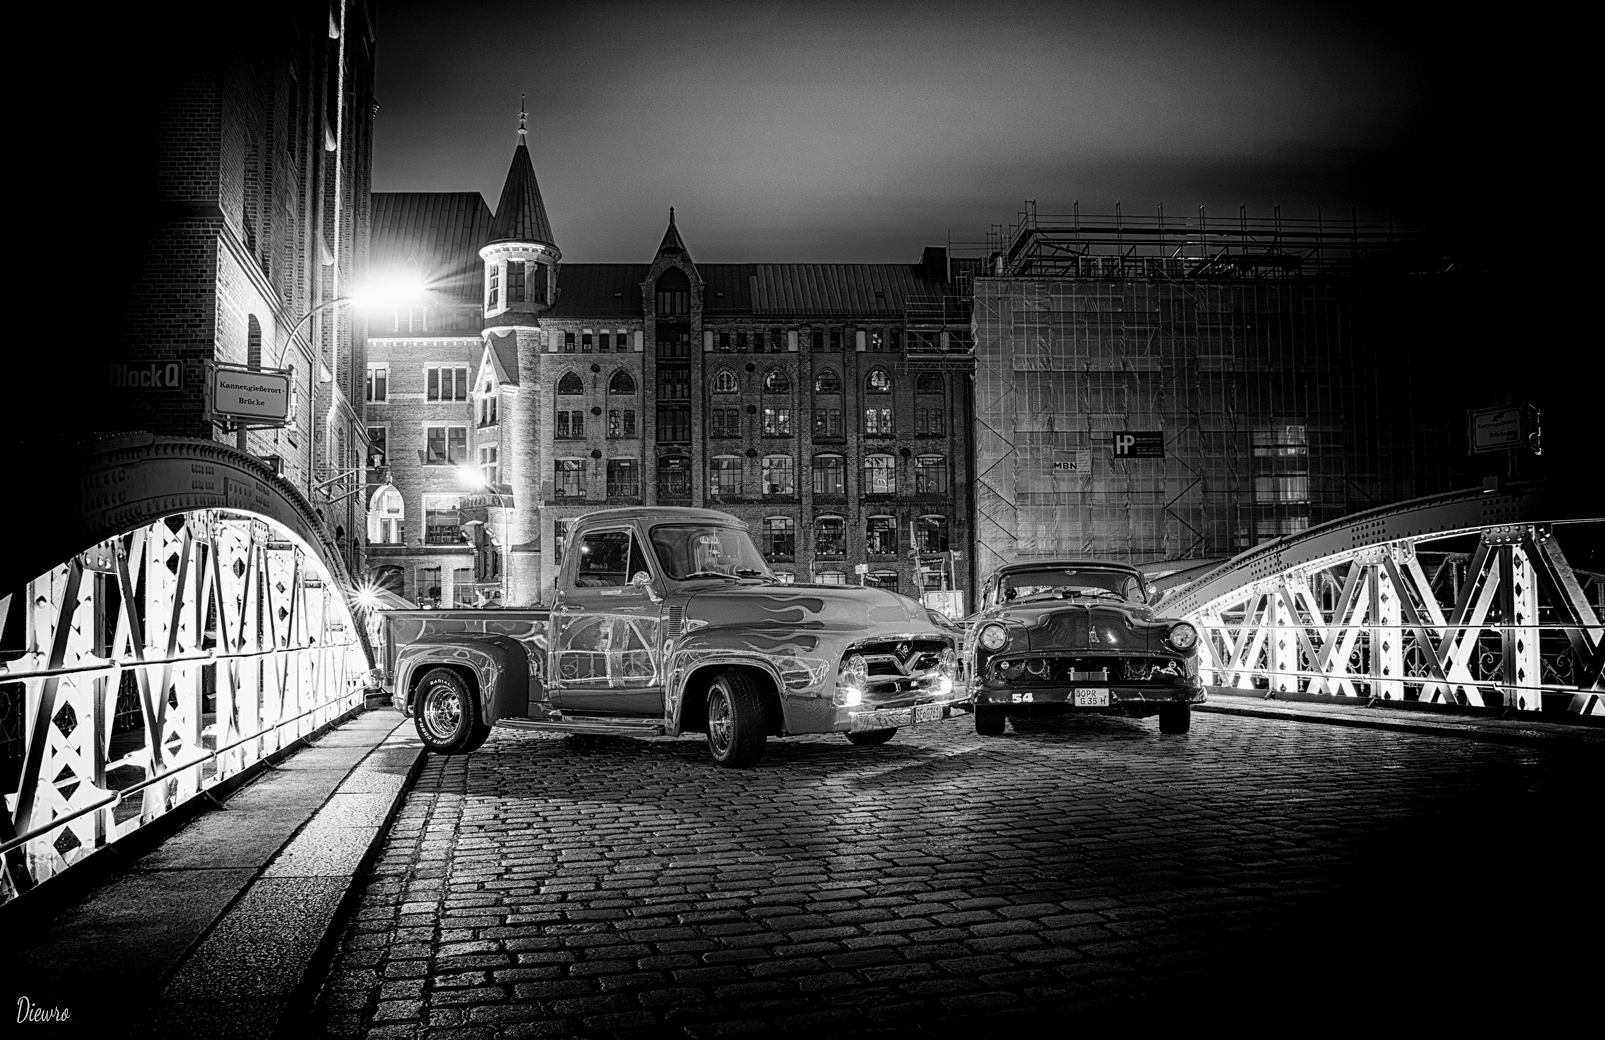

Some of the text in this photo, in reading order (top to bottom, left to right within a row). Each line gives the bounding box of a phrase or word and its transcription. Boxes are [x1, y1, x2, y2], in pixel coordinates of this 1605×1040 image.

[109, 363, 163, 388] Block
[238, 397, 265, 407] Brücke
[1115, 434, 1135, 455] HP
[1054, 462, 1077, 470] MBN
[429, 678, 452, 687] RADIAL
[1012, 692, 1034, 703] 54
